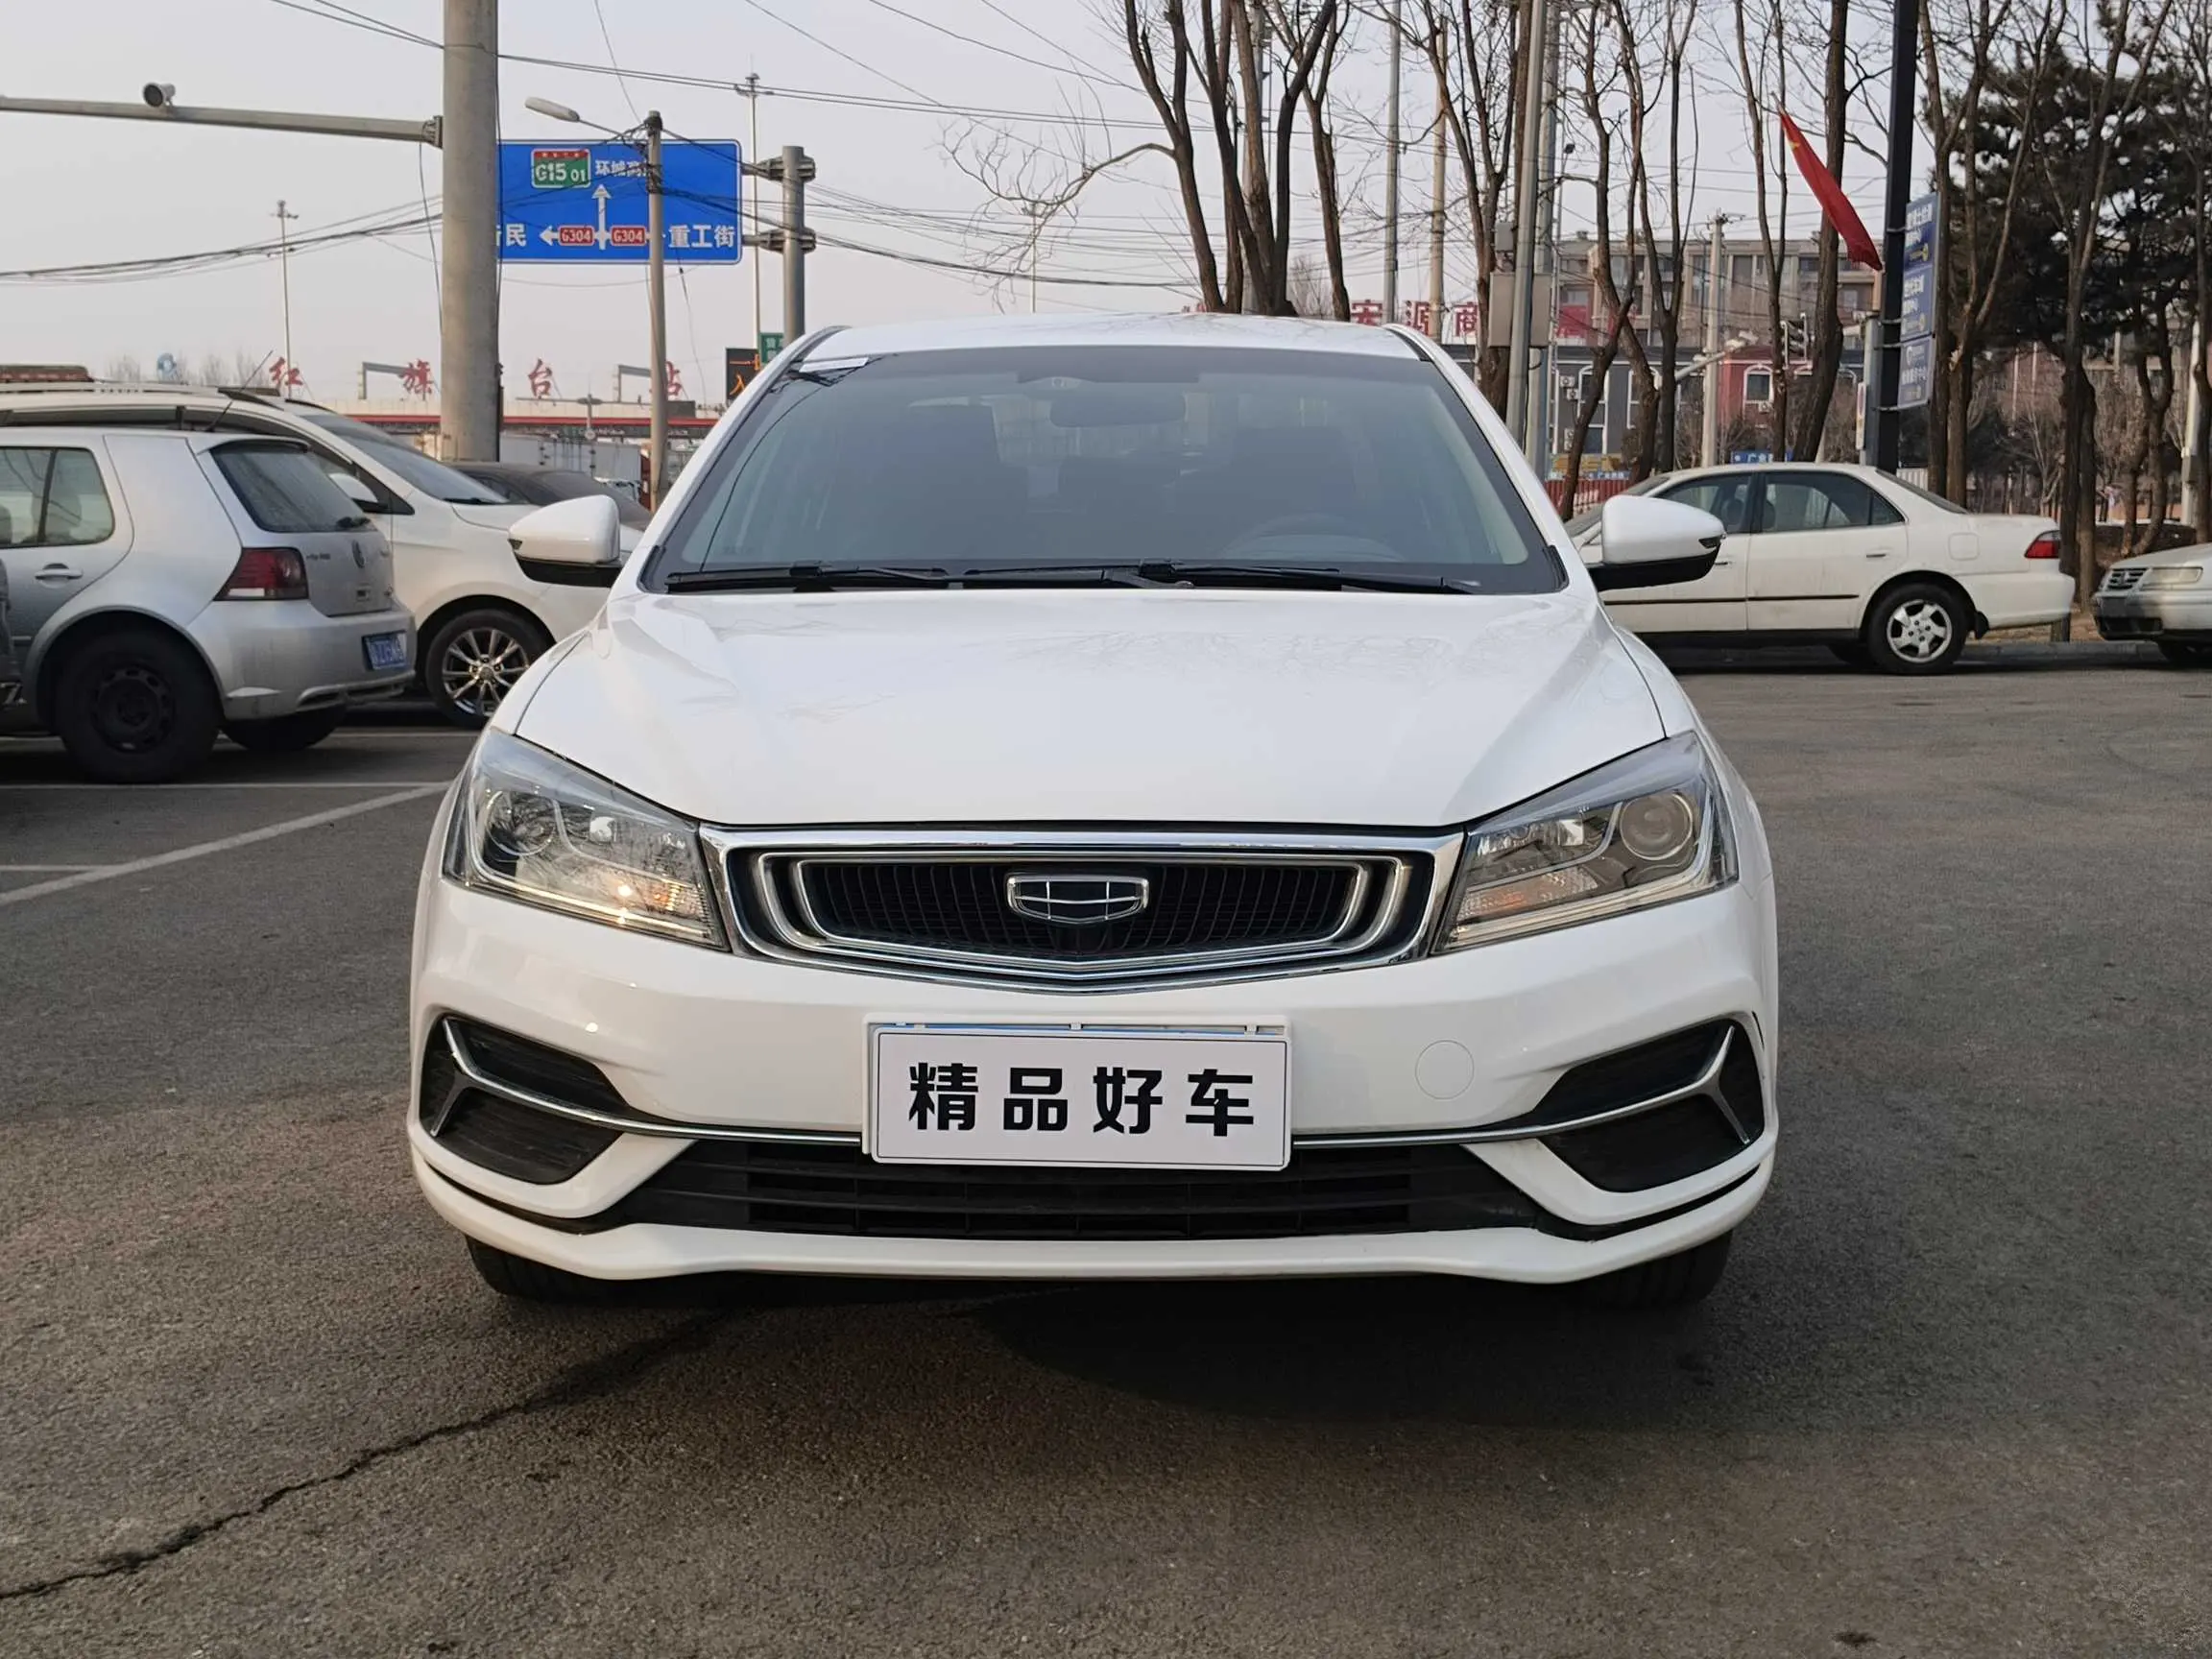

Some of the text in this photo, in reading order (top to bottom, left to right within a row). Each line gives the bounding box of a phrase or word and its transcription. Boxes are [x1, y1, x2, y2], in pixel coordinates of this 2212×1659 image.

[495, 224, 527, 248] 民
[562, 230, 591, 244] G304
[613, 230, 643, 244] G304
[669, 225, 735, 248] 重工街
[908, 1062, 1255, 1137] 精品好车
